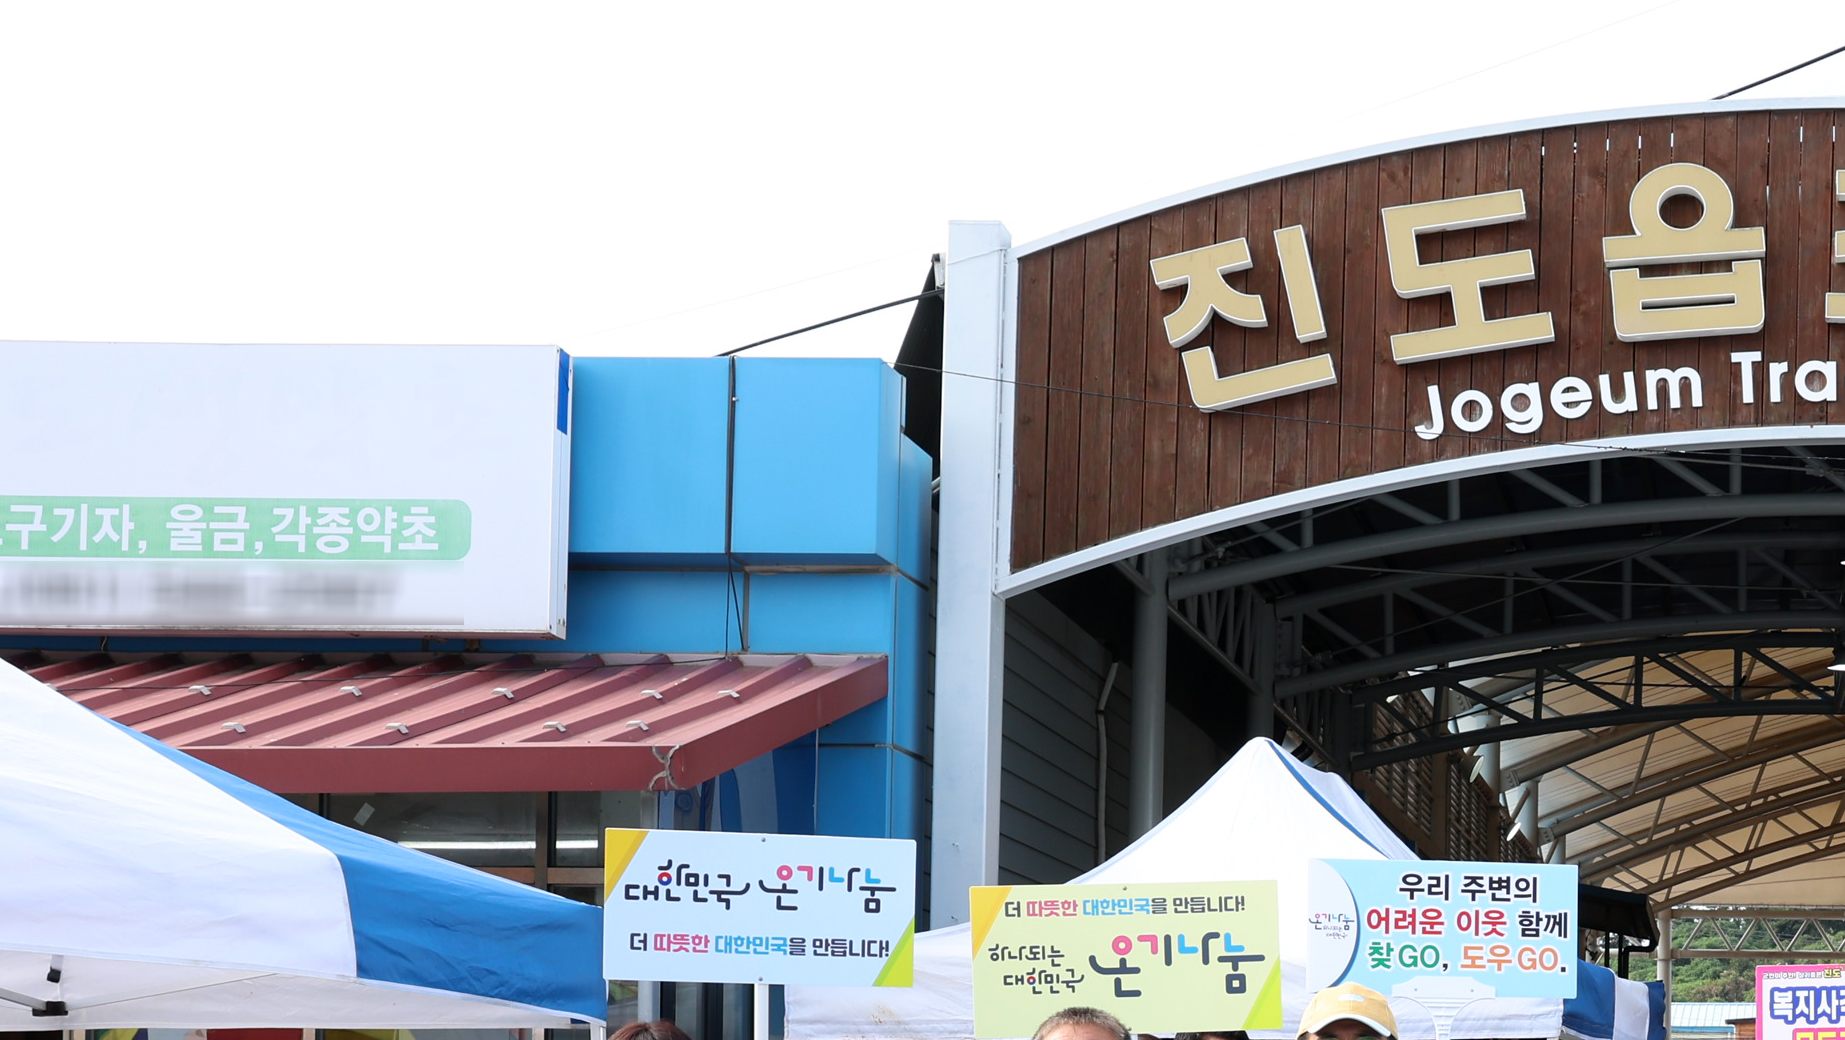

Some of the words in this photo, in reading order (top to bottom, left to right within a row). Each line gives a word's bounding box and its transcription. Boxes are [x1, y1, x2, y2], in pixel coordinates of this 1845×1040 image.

[1413, 366, 1703, 442] Jogeum
[0, 503, 148, 555] 구기자,
[758, 864, 897, 914] 온기나눔
[1399, 873, 1451, 903] 우리
[1460, 873, 1539, 904] 주변의
[1004, 900, 1022, 919] 더
[1026, 899, 1078, 917] 따뜻한
[1082, 898, 1168, 916] 대한민국을
[1172, 895, 1245, 914] 만듭니다!
[1365, 908, 1445, 938] 어려운
[1456, 909, 1508, 938] 이웃
[1517, 909, 1569, 940] 함께
[629, 932, 648, 952] 더
[653, 934, 710, 955] 따뜻한
[714, 935, 806, 957] 대한민국을
[812, 938, 890, 958] 만듭니다!
[988, 943, 1066, 967] 하나되는
[1088, 931, 1266, 998] 온기나눔
[1003, 967, 1085, 995] 대한민국
